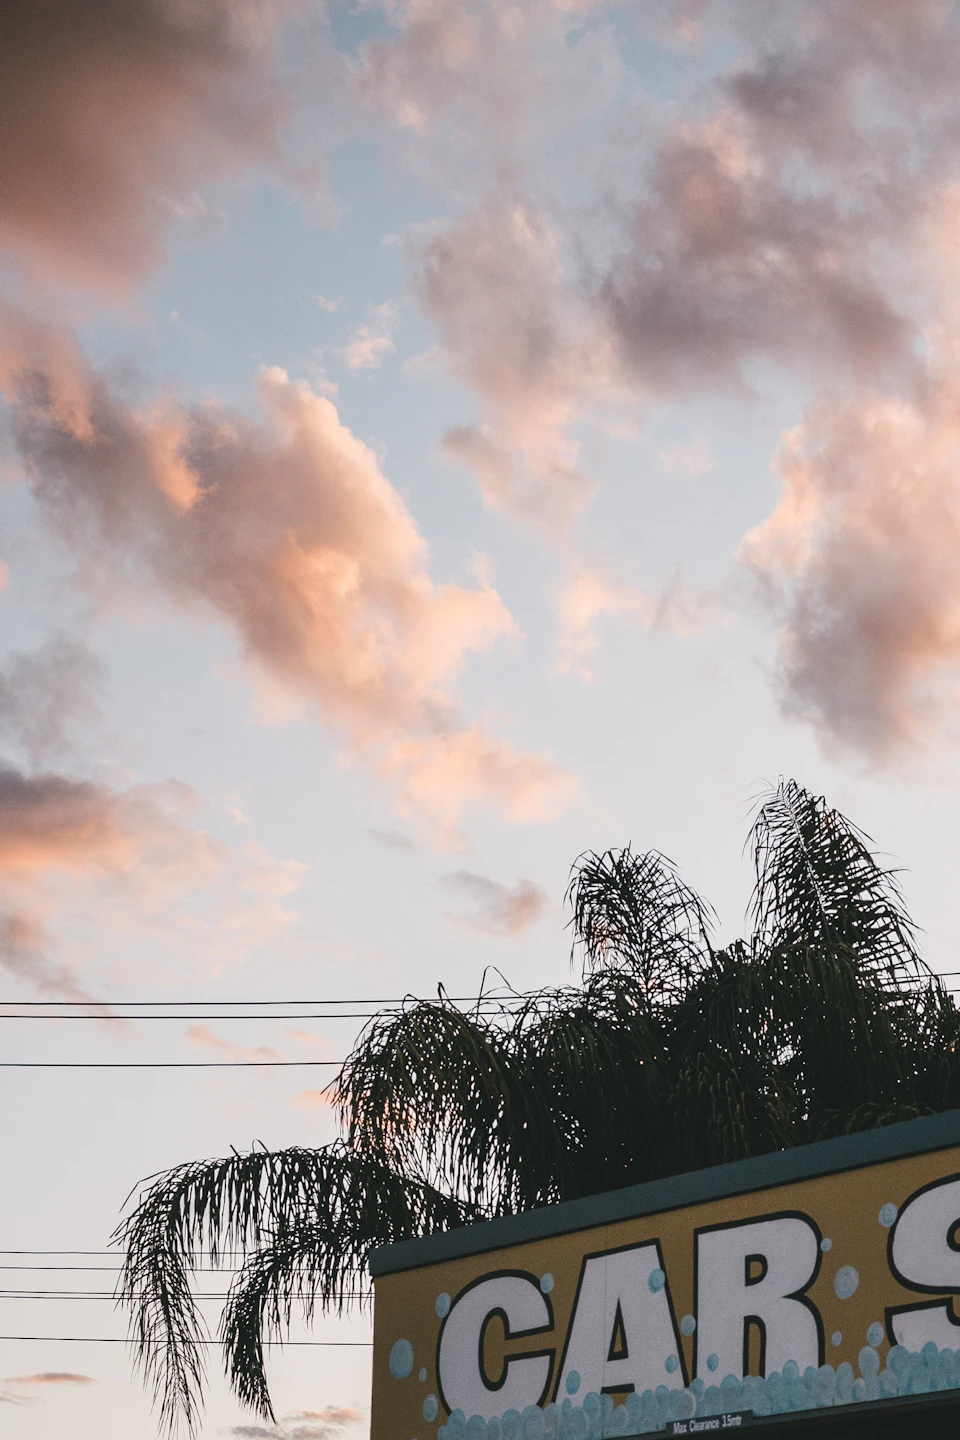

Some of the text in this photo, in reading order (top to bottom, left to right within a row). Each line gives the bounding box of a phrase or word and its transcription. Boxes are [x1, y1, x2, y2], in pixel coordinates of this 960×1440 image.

[435, 1209, 826, 1417] CAR
[673, 1414, 742, 1434] Max Clearance 3.5mtr
